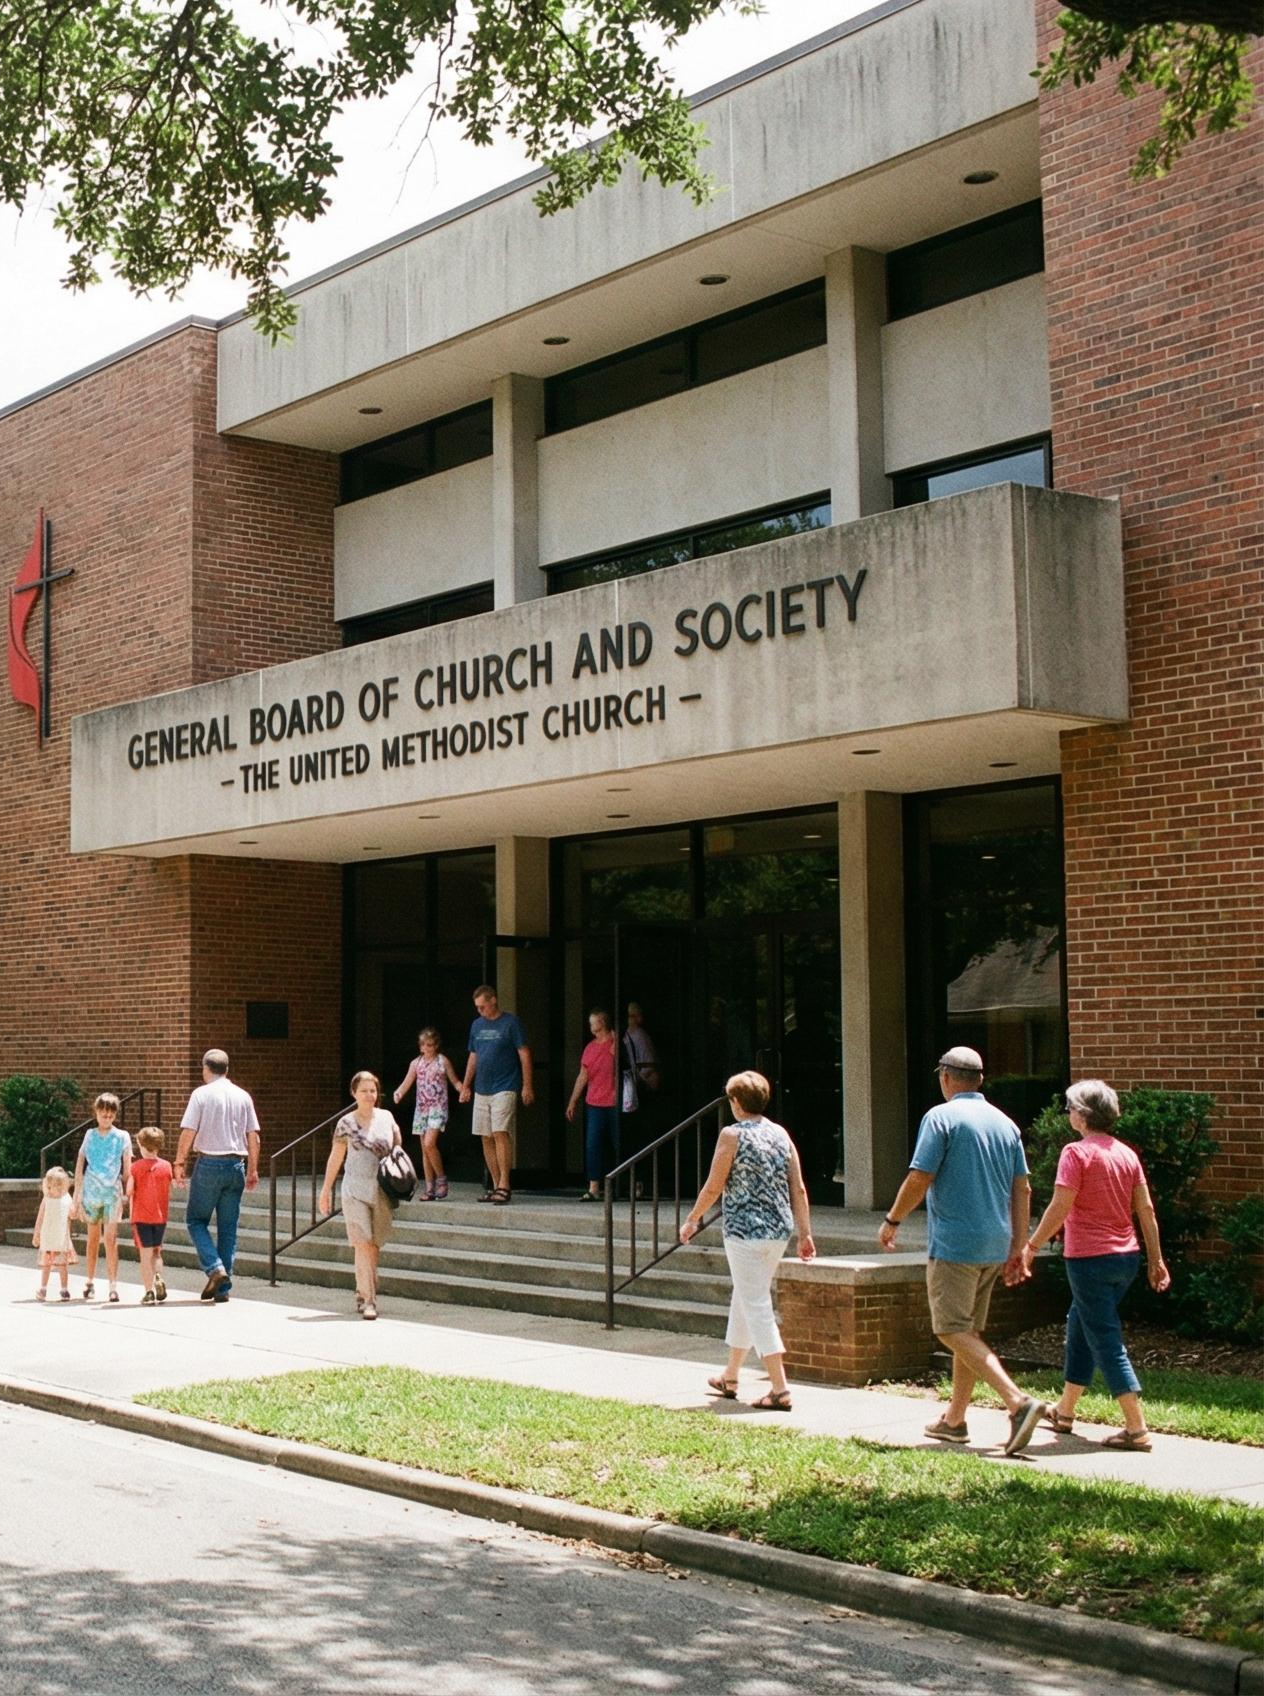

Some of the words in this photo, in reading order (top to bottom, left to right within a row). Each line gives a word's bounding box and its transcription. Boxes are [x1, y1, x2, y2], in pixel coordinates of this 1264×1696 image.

[128, 714, 238, 771] GENERAL
[249, 690, 345, 746] BOARD
[358, 676, 399, 723] OF
[414, 641, 553, 711] CHURCH
[571, 621, 653, 680] AND
[674, 567, 869, 658] SOCIETY
[289, 743, 370, 786] UNITED
[382, 711, 529, 771] METHODIST
[542, 684, 666, 742] CHURCH
